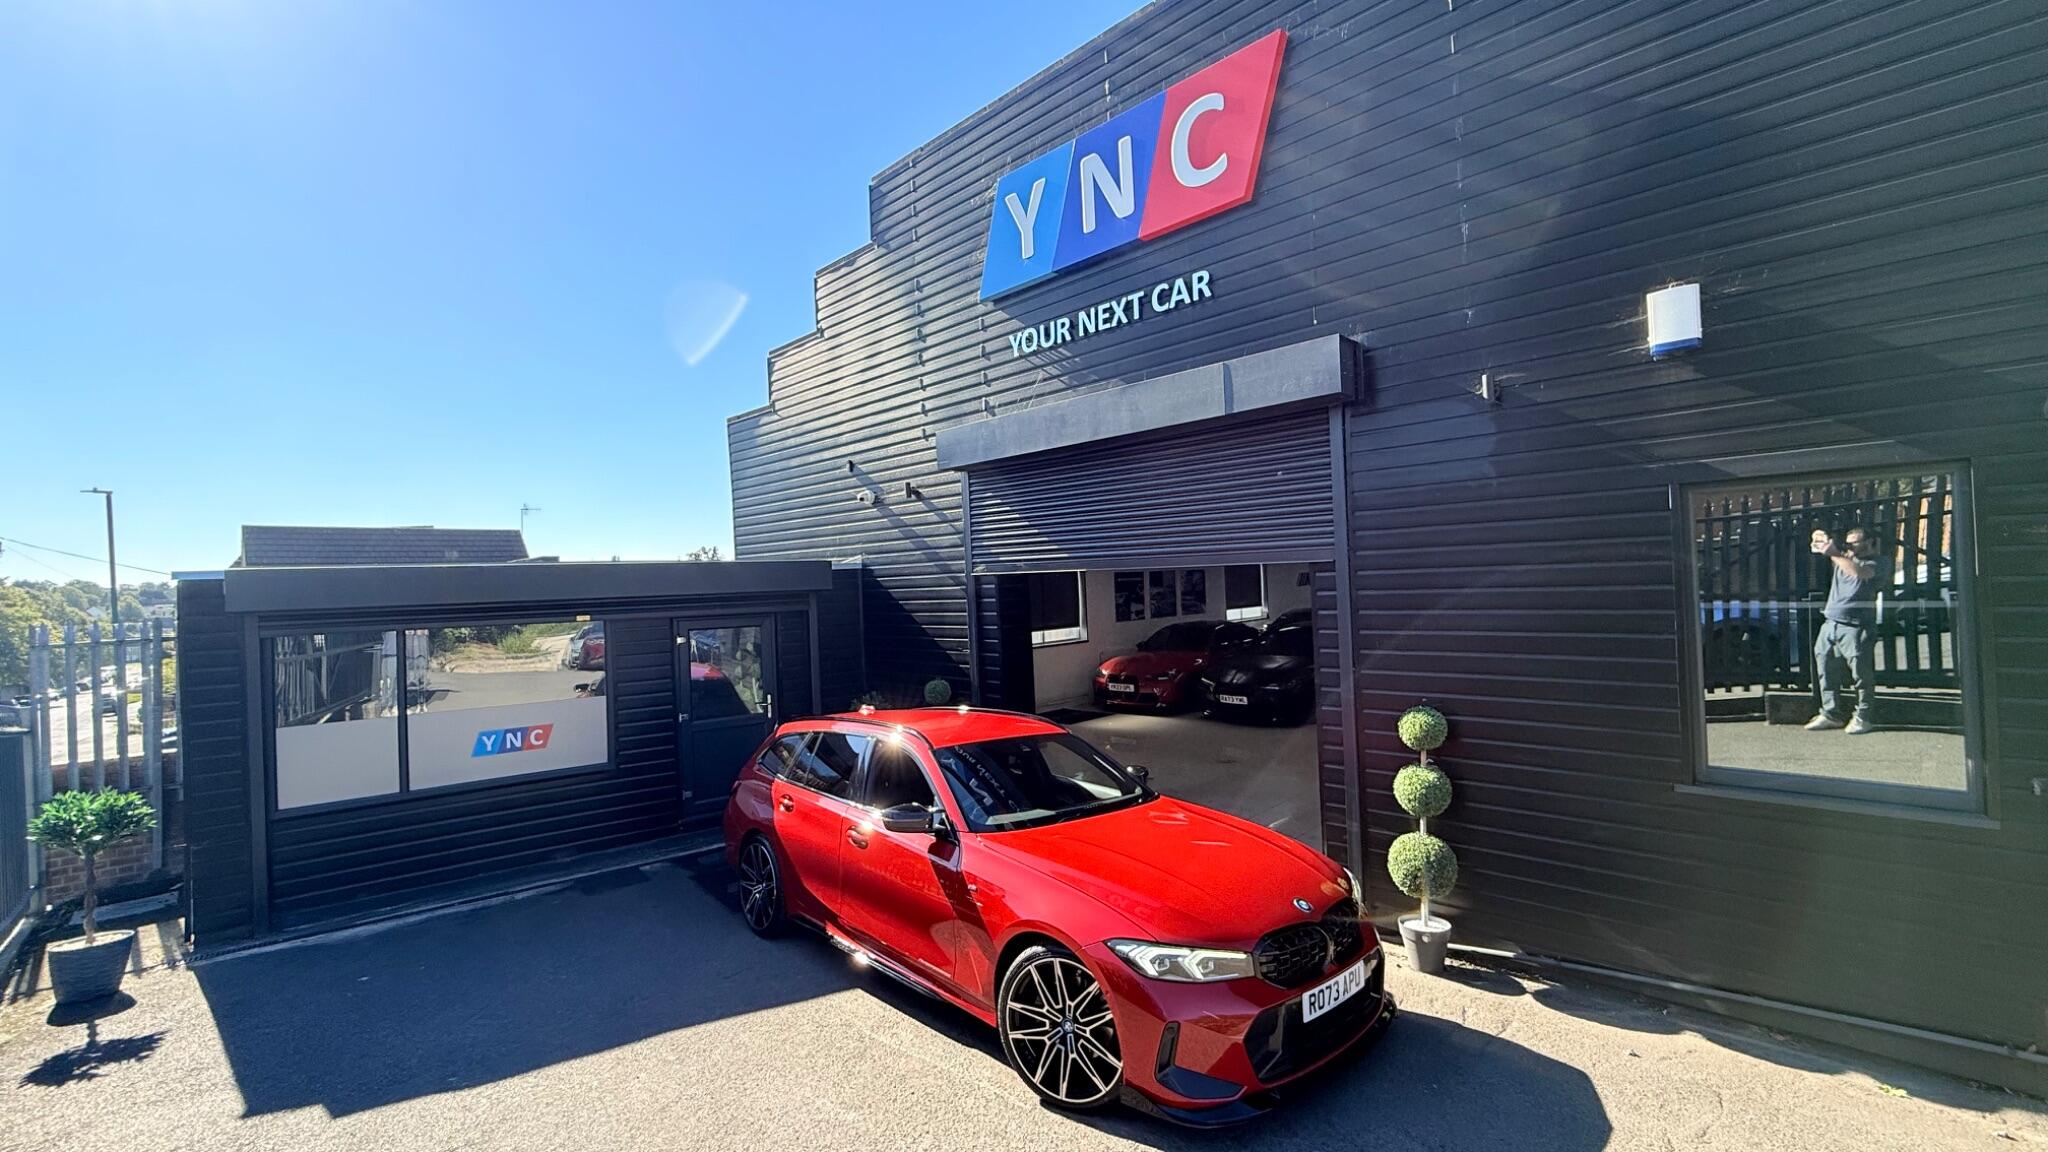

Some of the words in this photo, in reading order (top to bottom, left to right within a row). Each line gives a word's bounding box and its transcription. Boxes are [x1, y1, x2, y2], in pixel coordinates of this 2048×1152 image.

[1004, 92, 1228, 260] YNC
[1009, 317, 1071, 357] YOUR
[1078, 291, 1144, 337] NEXT
[1151, 270, 1212, 312] CAR
[482, 729, 543, 752] YNC
[1342, 965, 1361, 997] APU
